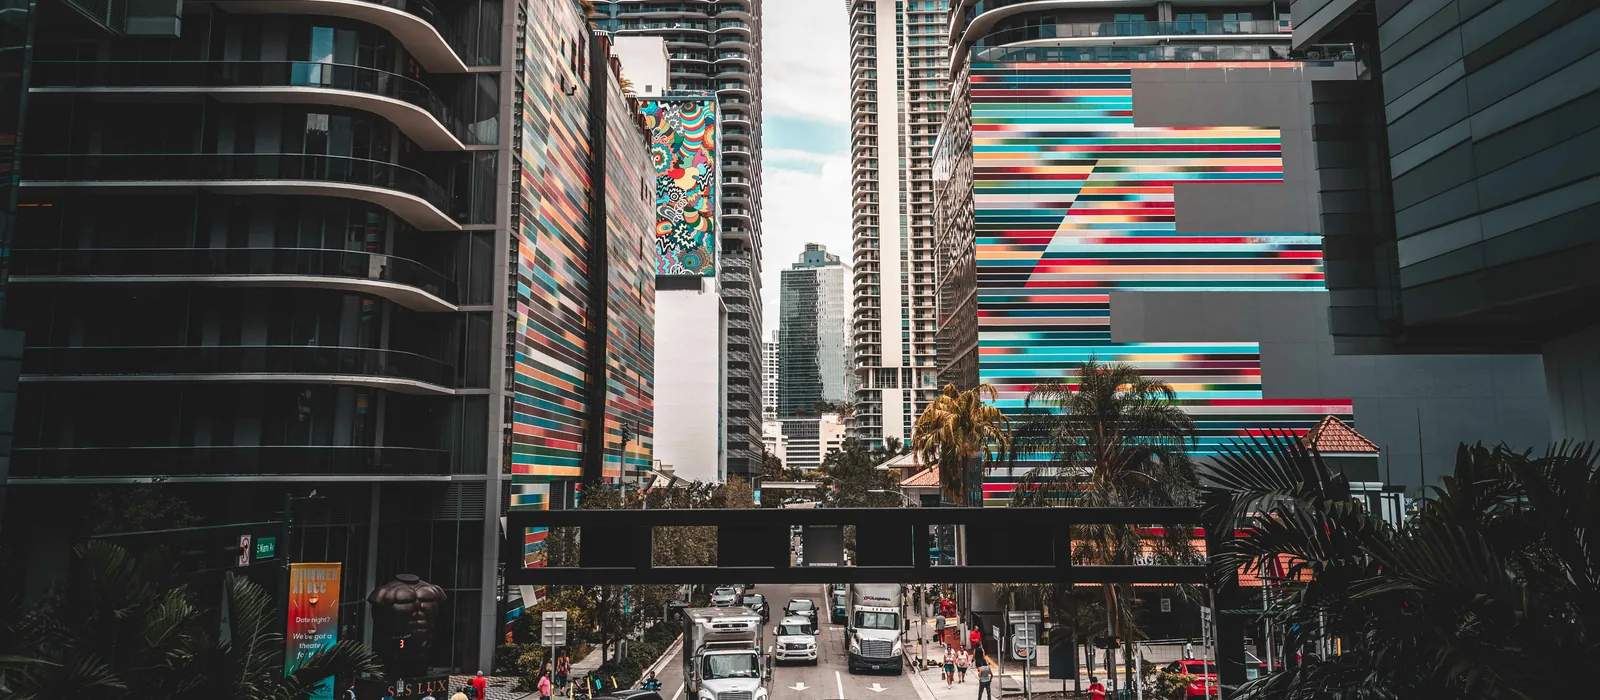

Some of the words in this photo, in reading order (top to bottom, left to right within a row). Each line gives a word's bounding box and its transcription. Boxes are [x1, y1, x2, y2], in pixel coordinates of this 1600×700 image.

[294, 568, 338, 580] SUMMER
[292, 582, 304, 594] AT
[307, 582, 326, 594] BCC
[400, 640, 404, 648] 3
[388, 684, 412, 698] SS
